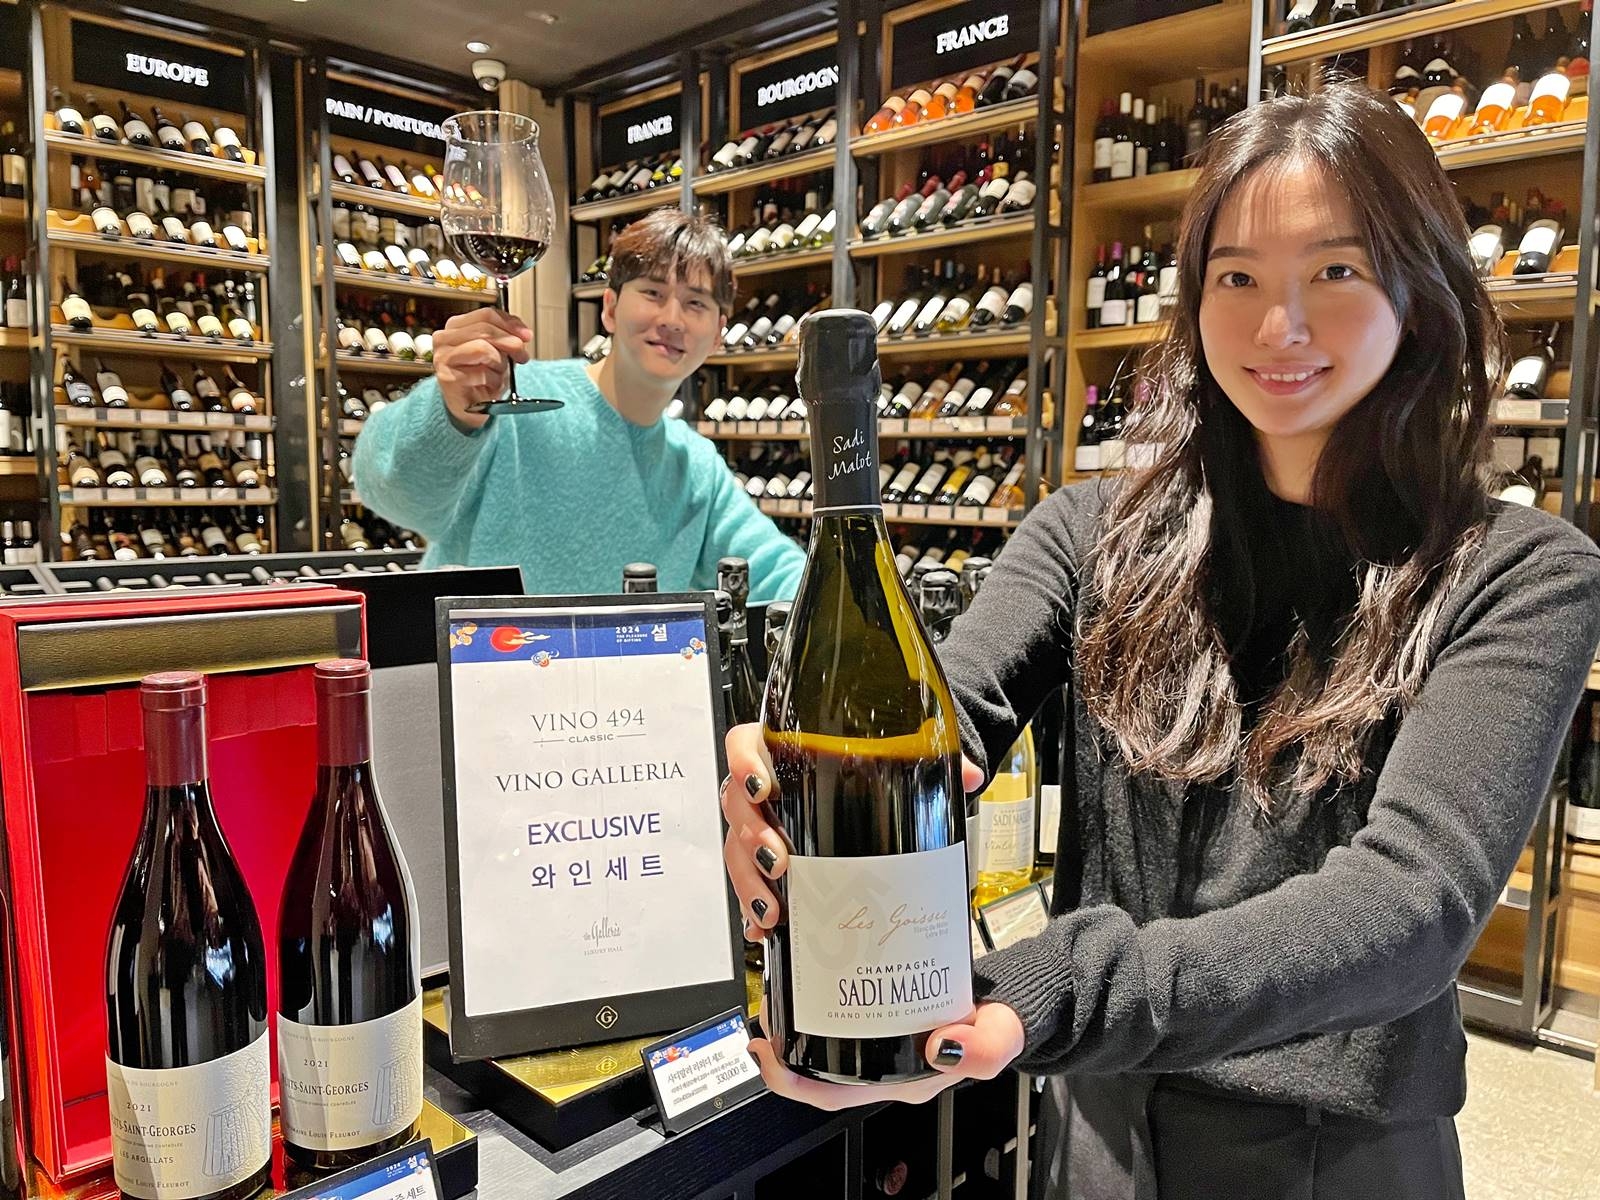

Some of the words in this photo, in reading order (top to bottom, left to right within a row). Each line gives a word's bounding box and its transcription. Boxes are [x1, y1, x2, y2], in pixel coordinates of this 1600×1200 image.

[936, 14, 1009, 55] FRANCE
[125, 52, 210, 88] EUROPE
[627, 114, 673, 144] FRANCE
[832, 428, 865, 454] Sadi
[827, 450, 872, 480] Malot
[615, 625, 640, 634] 2024
[650, 623, 668, 642] 설
[531, 710, 598, 732] VINO
[606, 707, 645, 728] 494
[568, 733, 614, 744] CLASSIC
[496, 770, 563, 793] VINO
[572, 761, 686, 786] GALLERIA
[527, 812, 662, 845] EXCLUSIVE
[838, 905, 874, 930] Les
[856, 958, 936, 975] CHAMPAGNE
[838, 977, 884, 1007] SADI
[890, 966, 950, 1005] MALOT
[827, 1011, 860, 1020] GRAND
[865, 1011, 883, 1019] VIN
[888, 1010, 899, 1018] DE
[904, 999, 954, 1016] CHAMPAGNE
[303, 1058, 328, 1068] 2021
[126, 1102, 152, 1112] 2021
[131, 1154, 174, 1164] ARGILLATS
